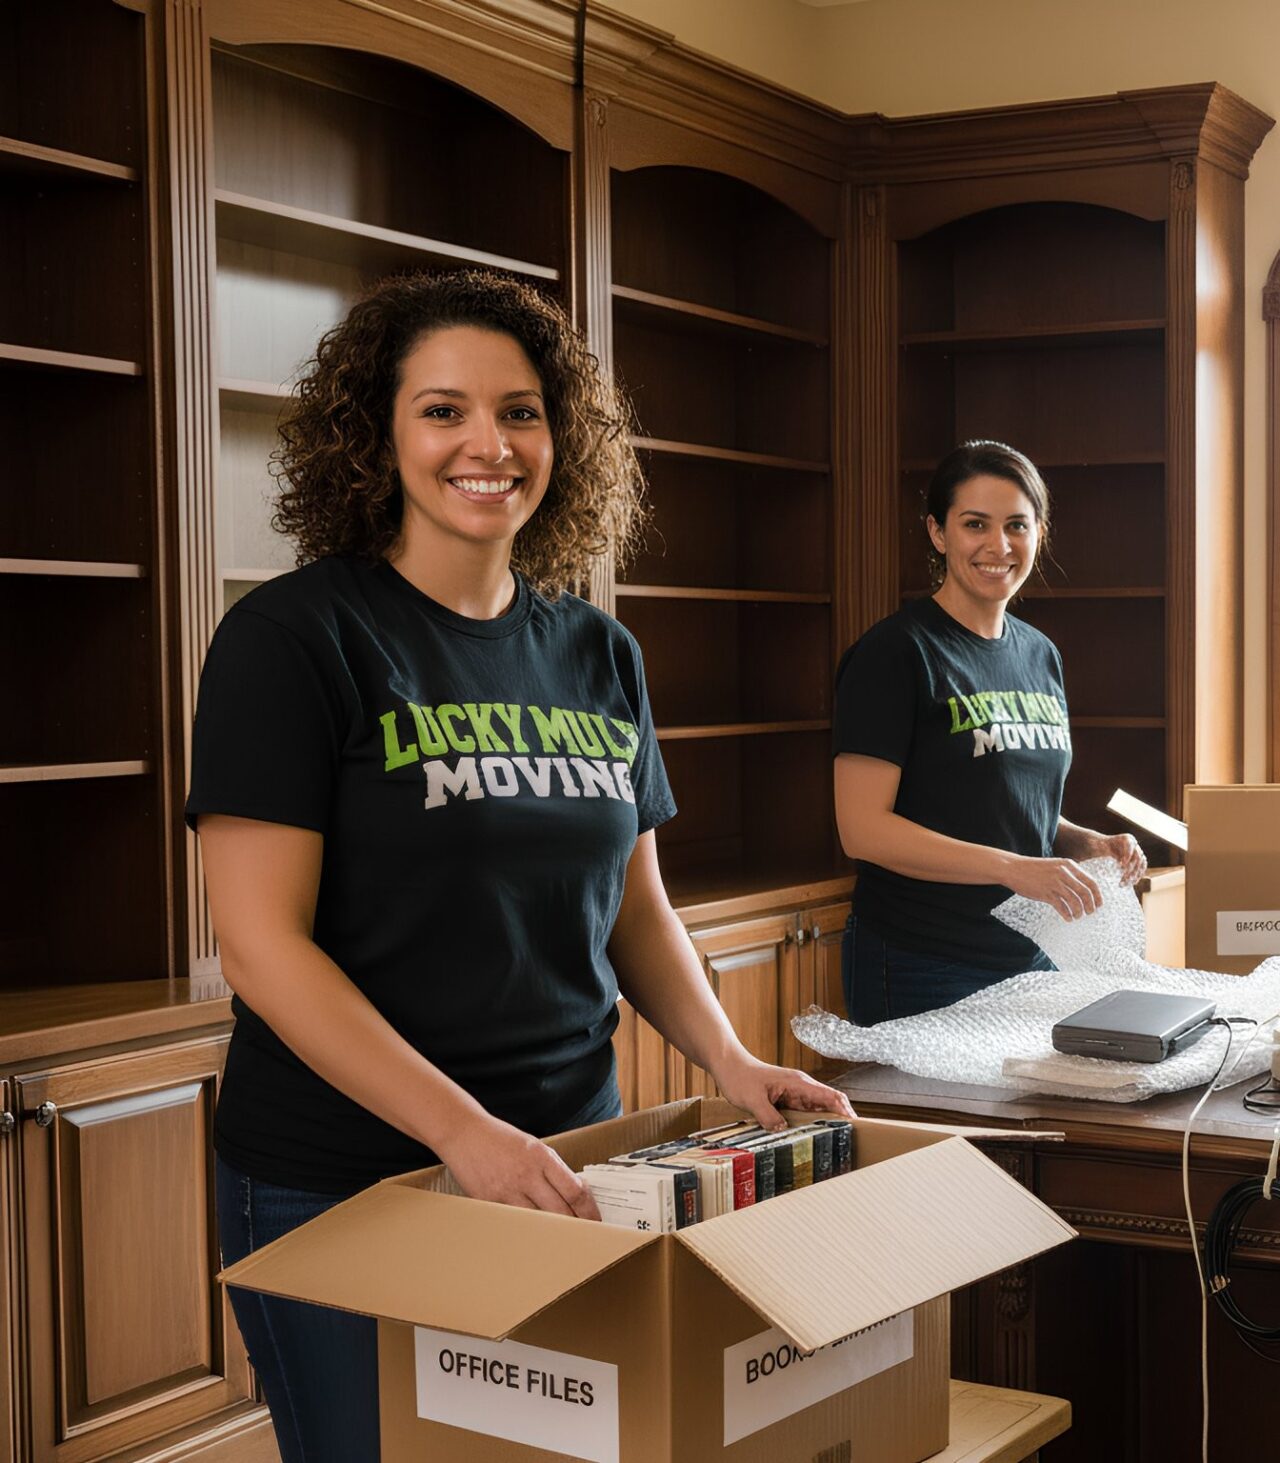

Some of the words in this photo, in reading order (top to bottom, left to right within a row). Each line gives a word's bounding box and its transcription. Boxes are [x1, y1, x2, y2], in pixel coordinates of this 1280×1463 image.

[379, 702, 530, 772] LUCKY
[973, 723, 1071, 758] MOVIN
[439, 1349, 519, 1389] OFFICE
[527, 1369, 594, 1406] FILES
